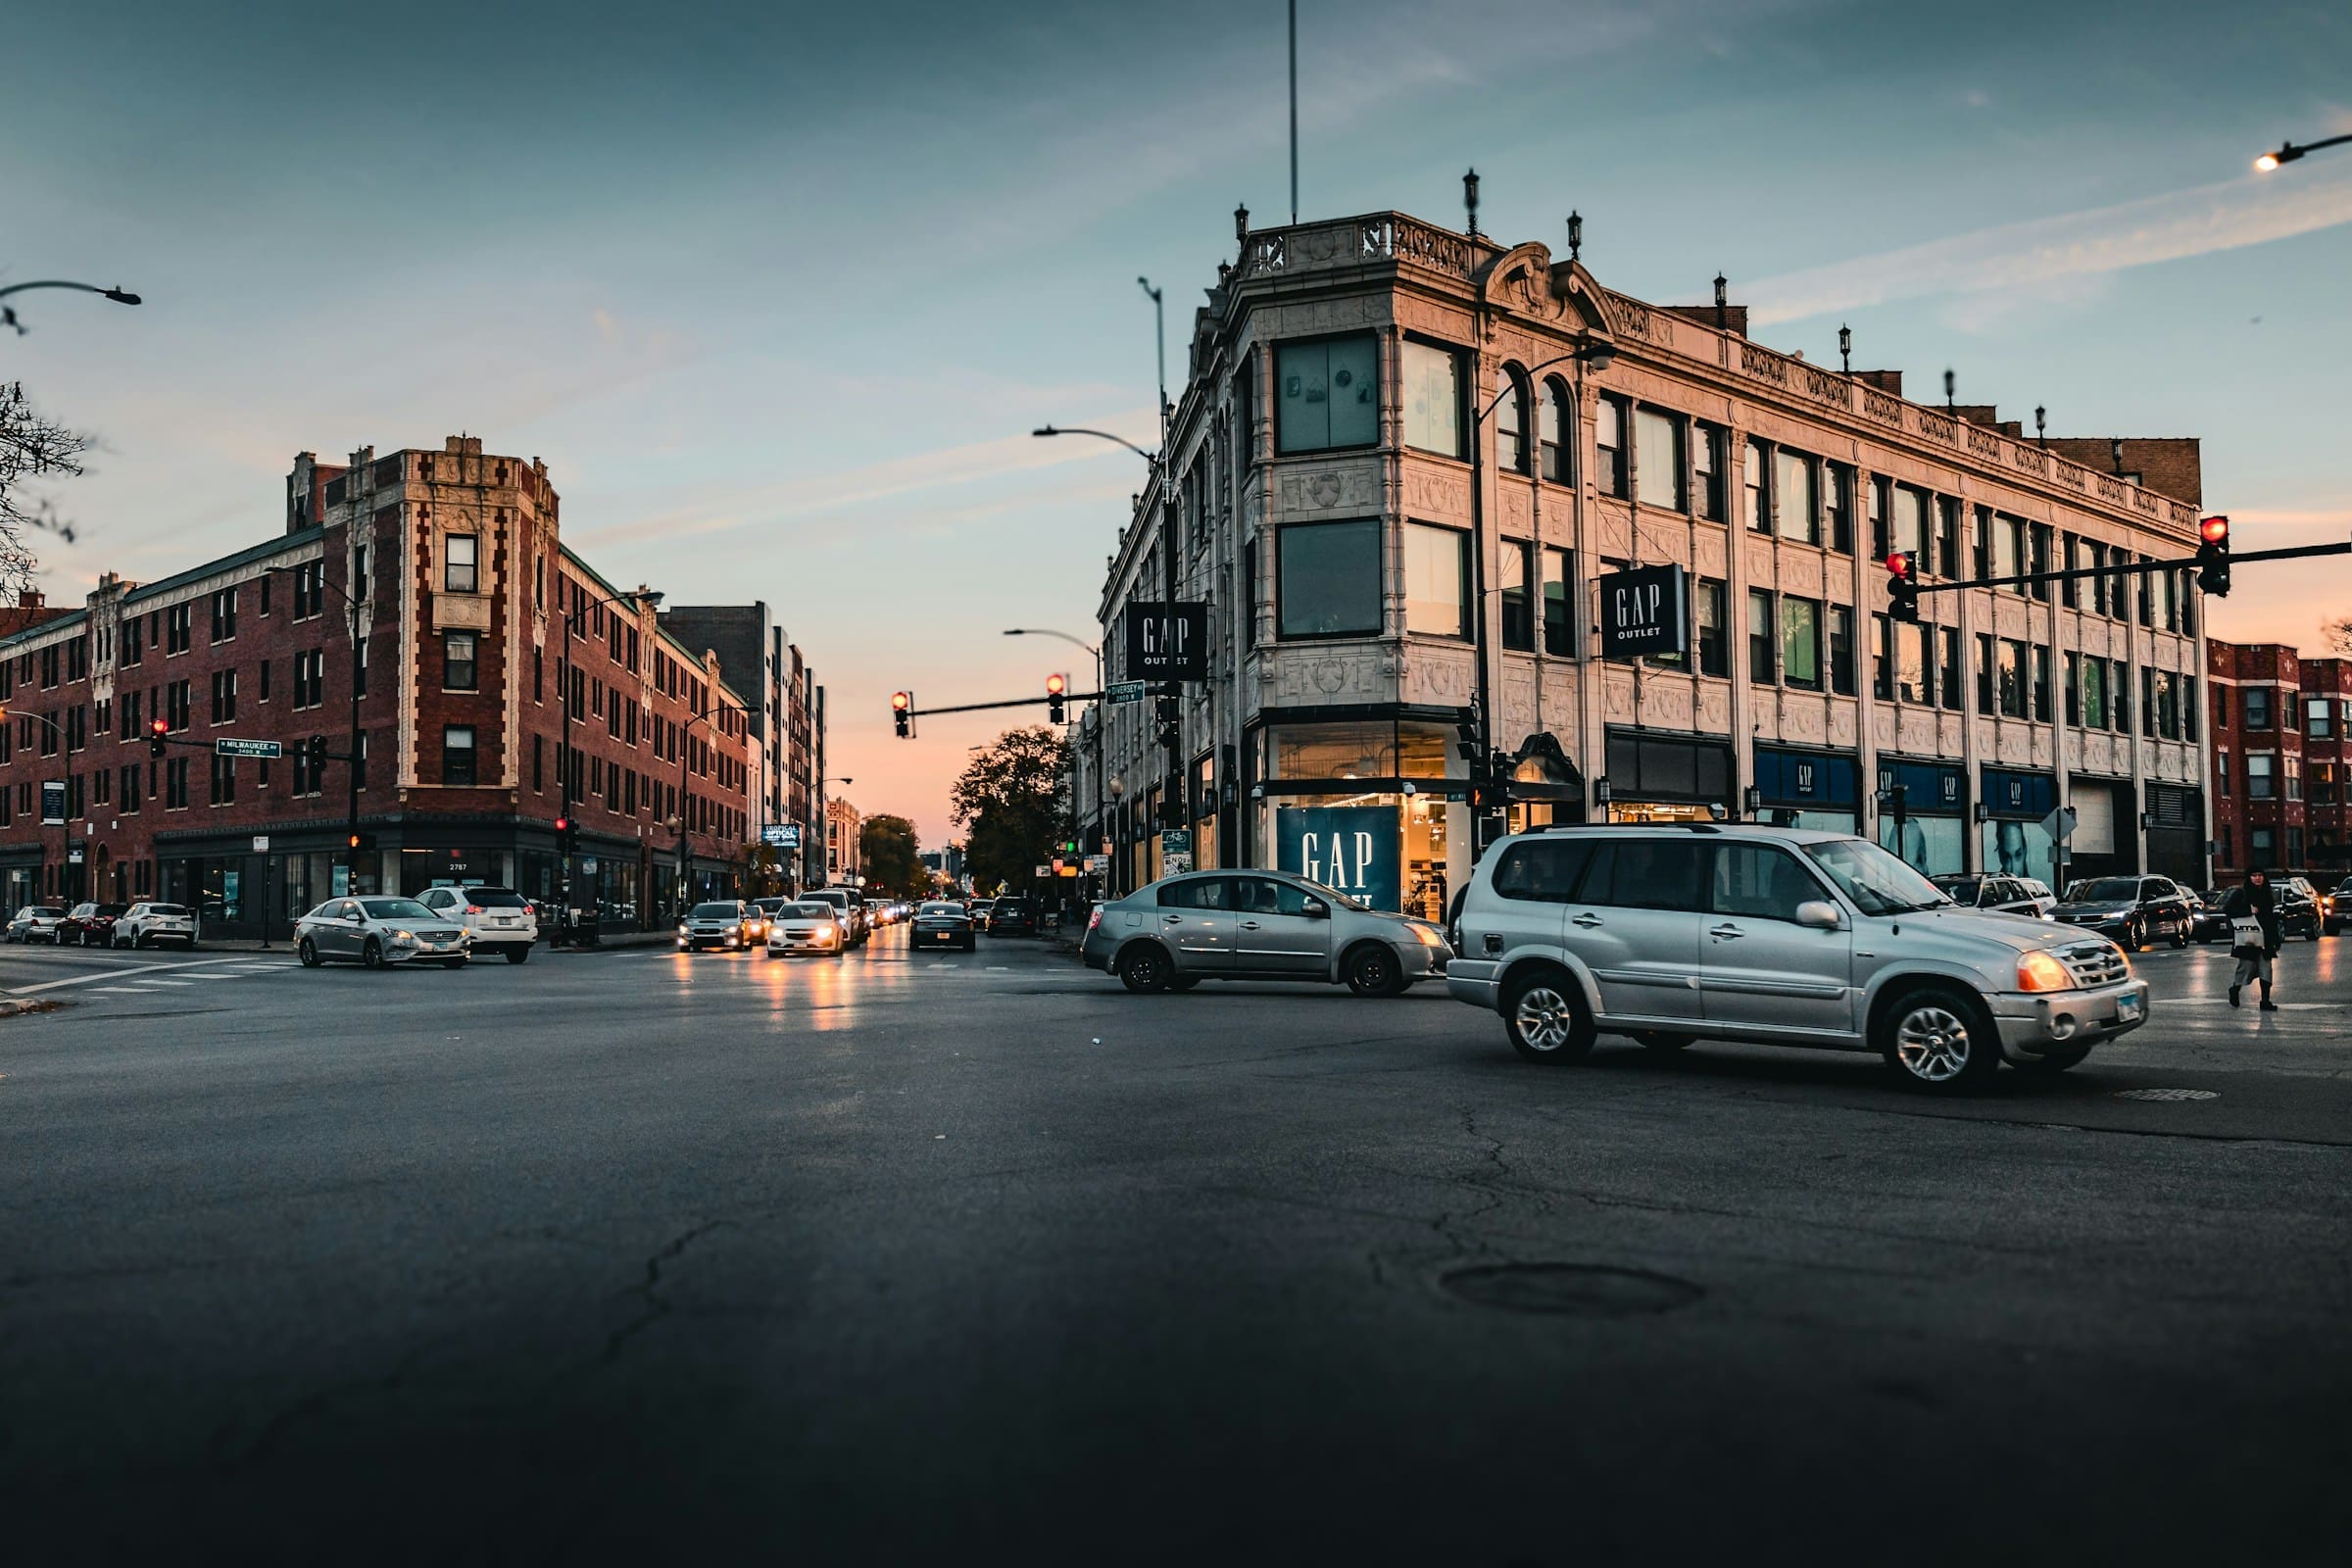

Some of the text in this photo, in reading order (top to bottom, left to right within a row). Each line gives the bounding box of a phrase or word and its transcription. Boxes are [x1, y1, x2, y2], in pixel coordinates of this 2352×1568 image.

[1616, 583, 1660, 627] GAP
[1143, 617, 1189, 654] GAP
[1618, 627, 1660, 640] OUTLET
[1144, 657, 1189, 665] OUTET
[226, 741, 269, 751] MILWAUKEE
[1799, 764, 1812, 786] GAP
[1302, 831, 1373, 889] GAP
